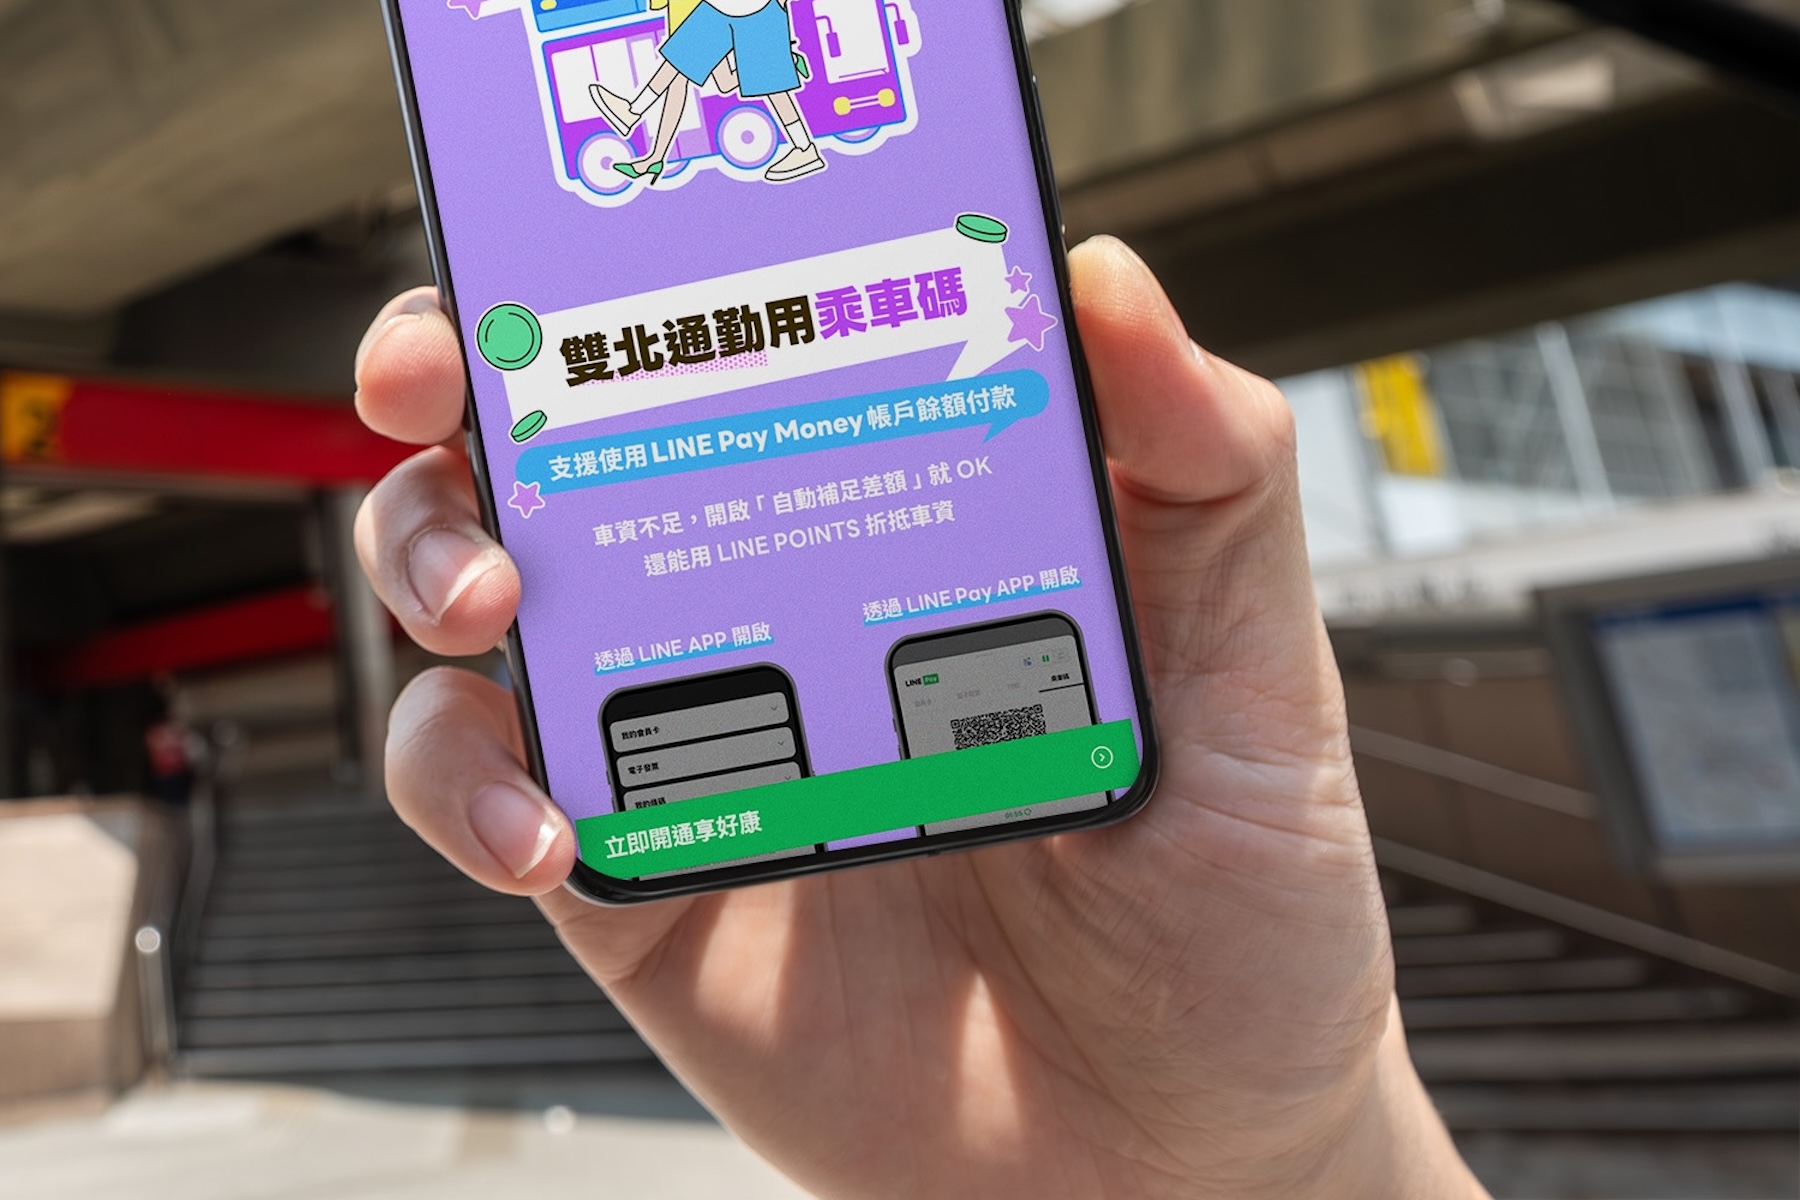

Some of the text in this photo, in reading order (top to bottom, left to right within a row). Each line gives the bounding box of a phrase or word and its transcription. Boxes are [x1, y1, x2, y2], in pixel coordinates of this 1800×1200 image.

[548, 383, 1017, 482] 支援使用 LINE Pay Money 帳戶餘額付款
[957, 456, 993, 479] OK
[643, 500, 955, 578] 還能用 LINE POINTS 折抵車資
[862, 564, 1081, 623] 透過 LINE Pay APP 開啟
[594, 621, 772, 672] 透過 LINE APP 開啟
[905, 677, 922, 687] LINE
[604, 810, 763, 860] 立即開通享好康
